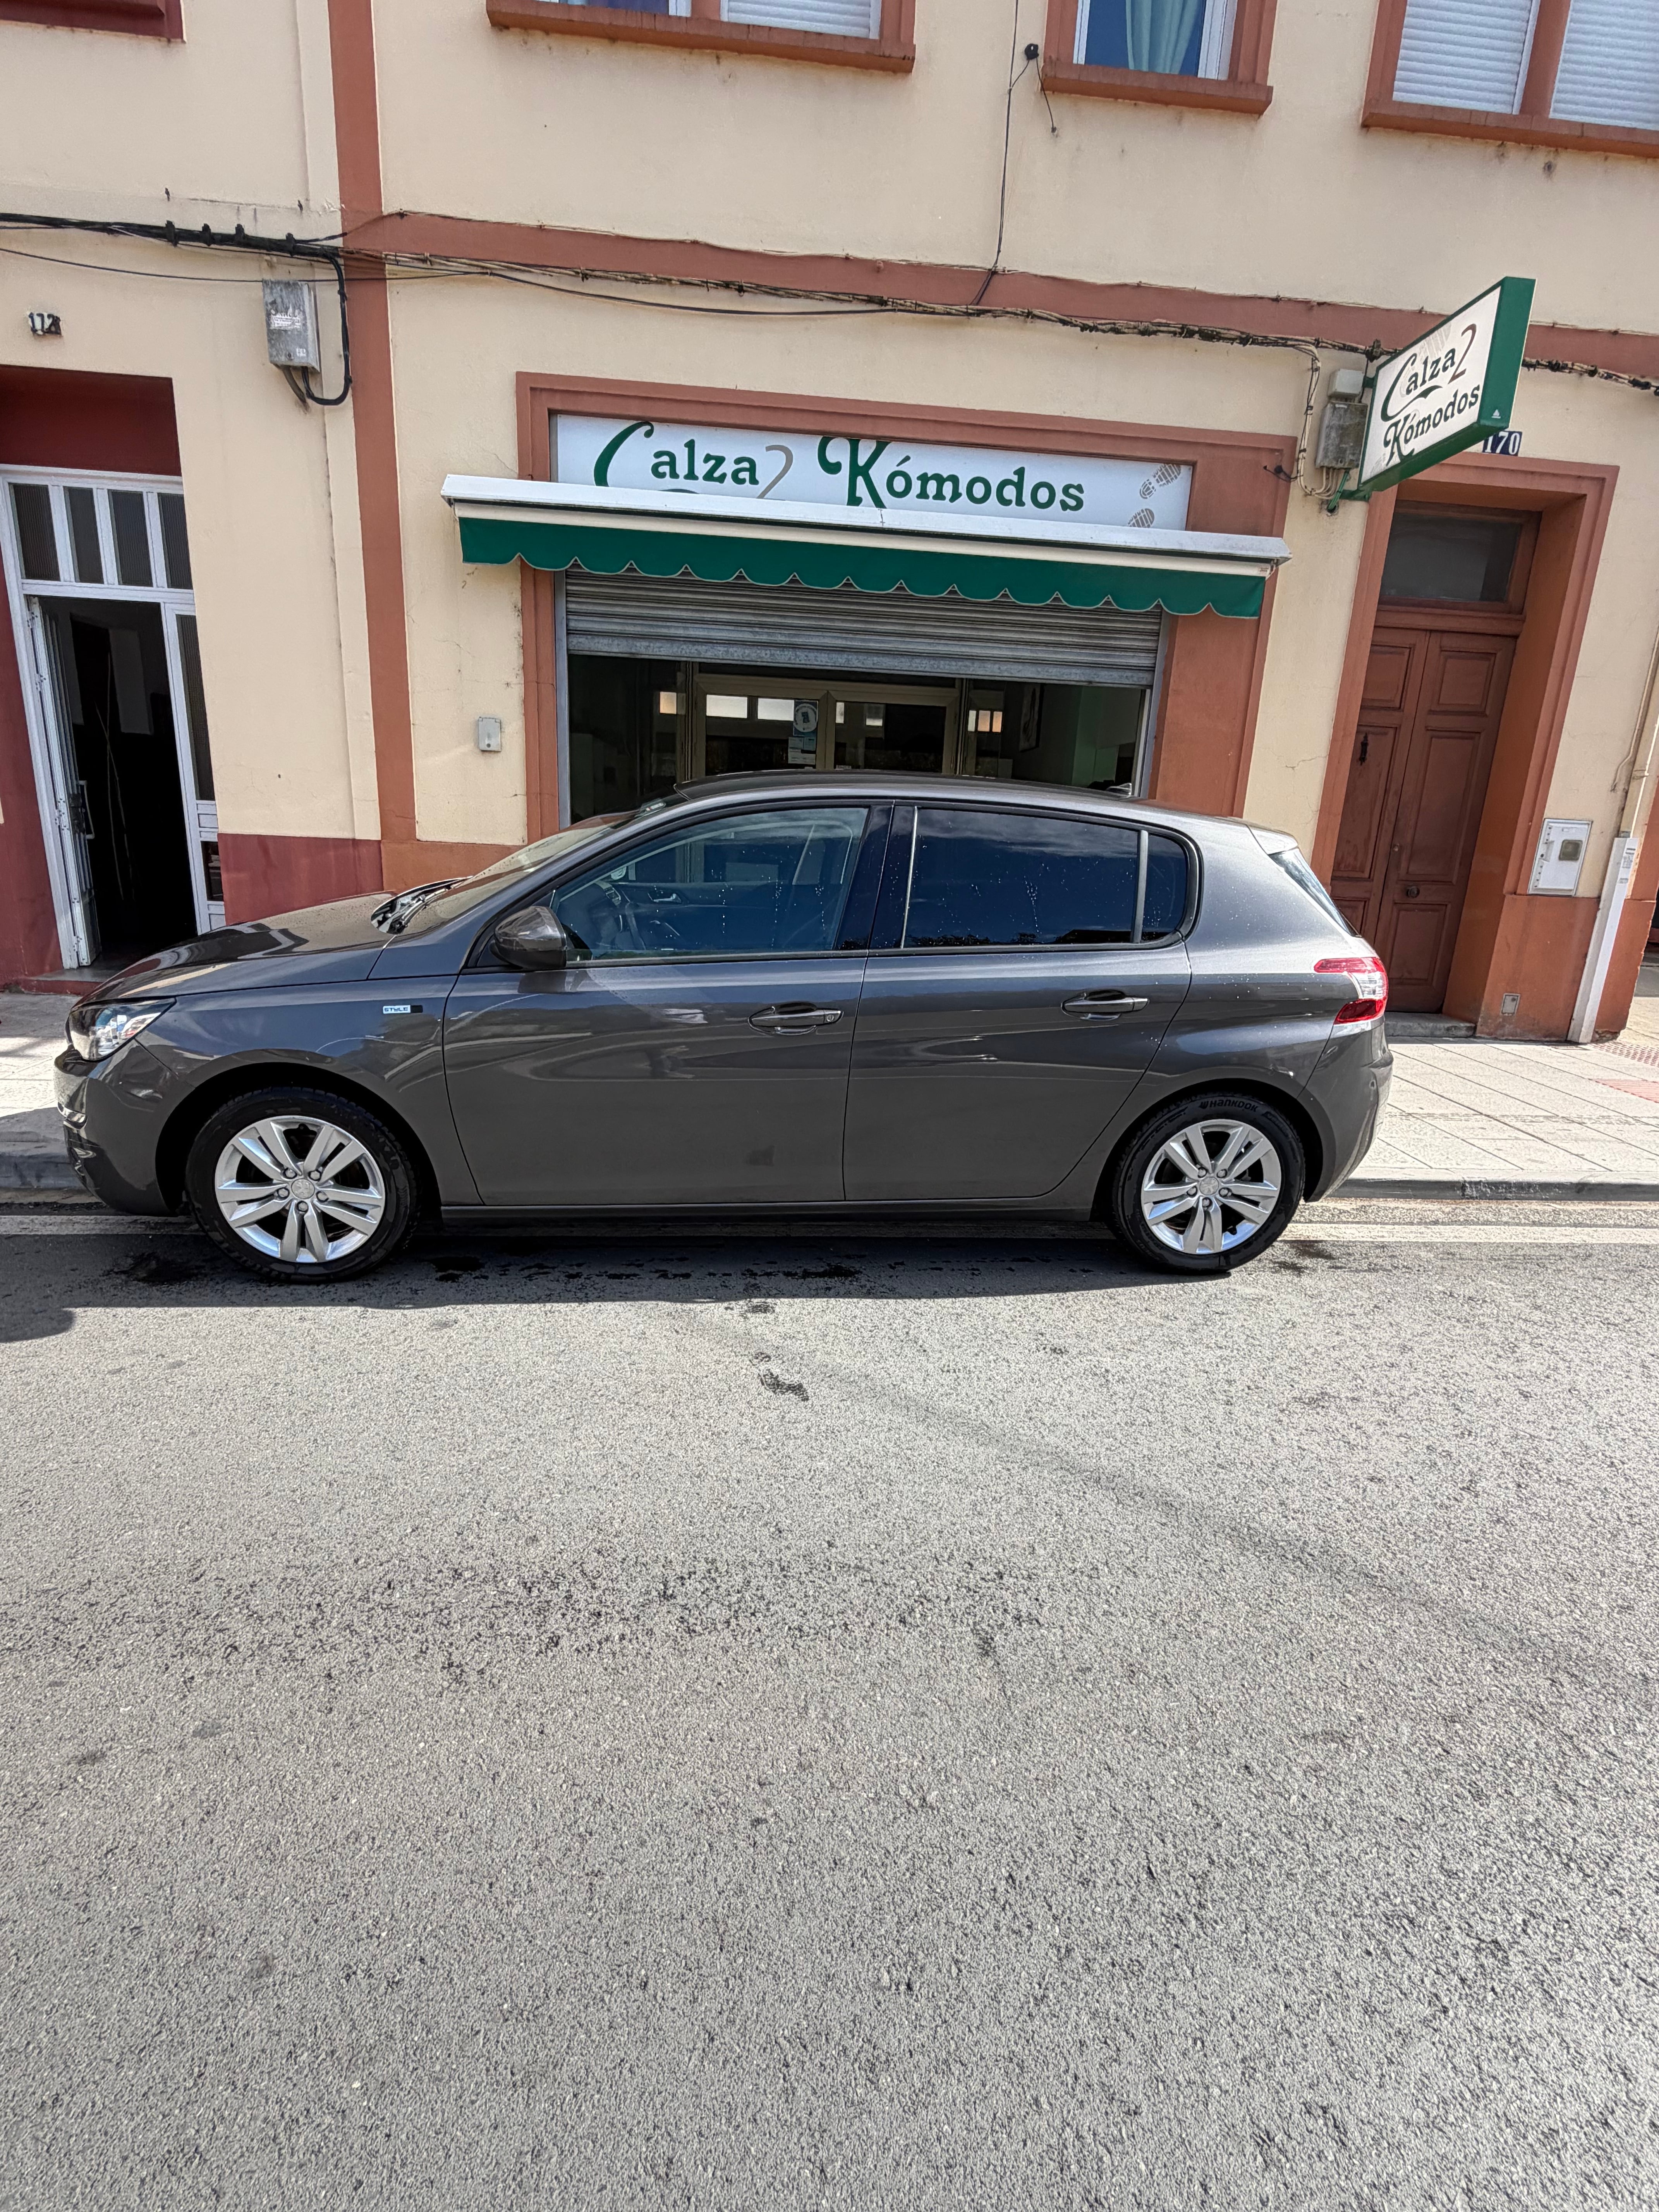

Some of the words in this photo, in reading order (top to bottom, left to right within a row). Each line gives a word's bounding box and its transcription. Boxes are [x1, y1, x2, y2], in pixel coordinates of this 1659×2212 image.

[1384, 385, 1480, 466] Kómodos
[1485, 431, 1520, 455] 170
[817, 436, 1084, 512] Kómodos
